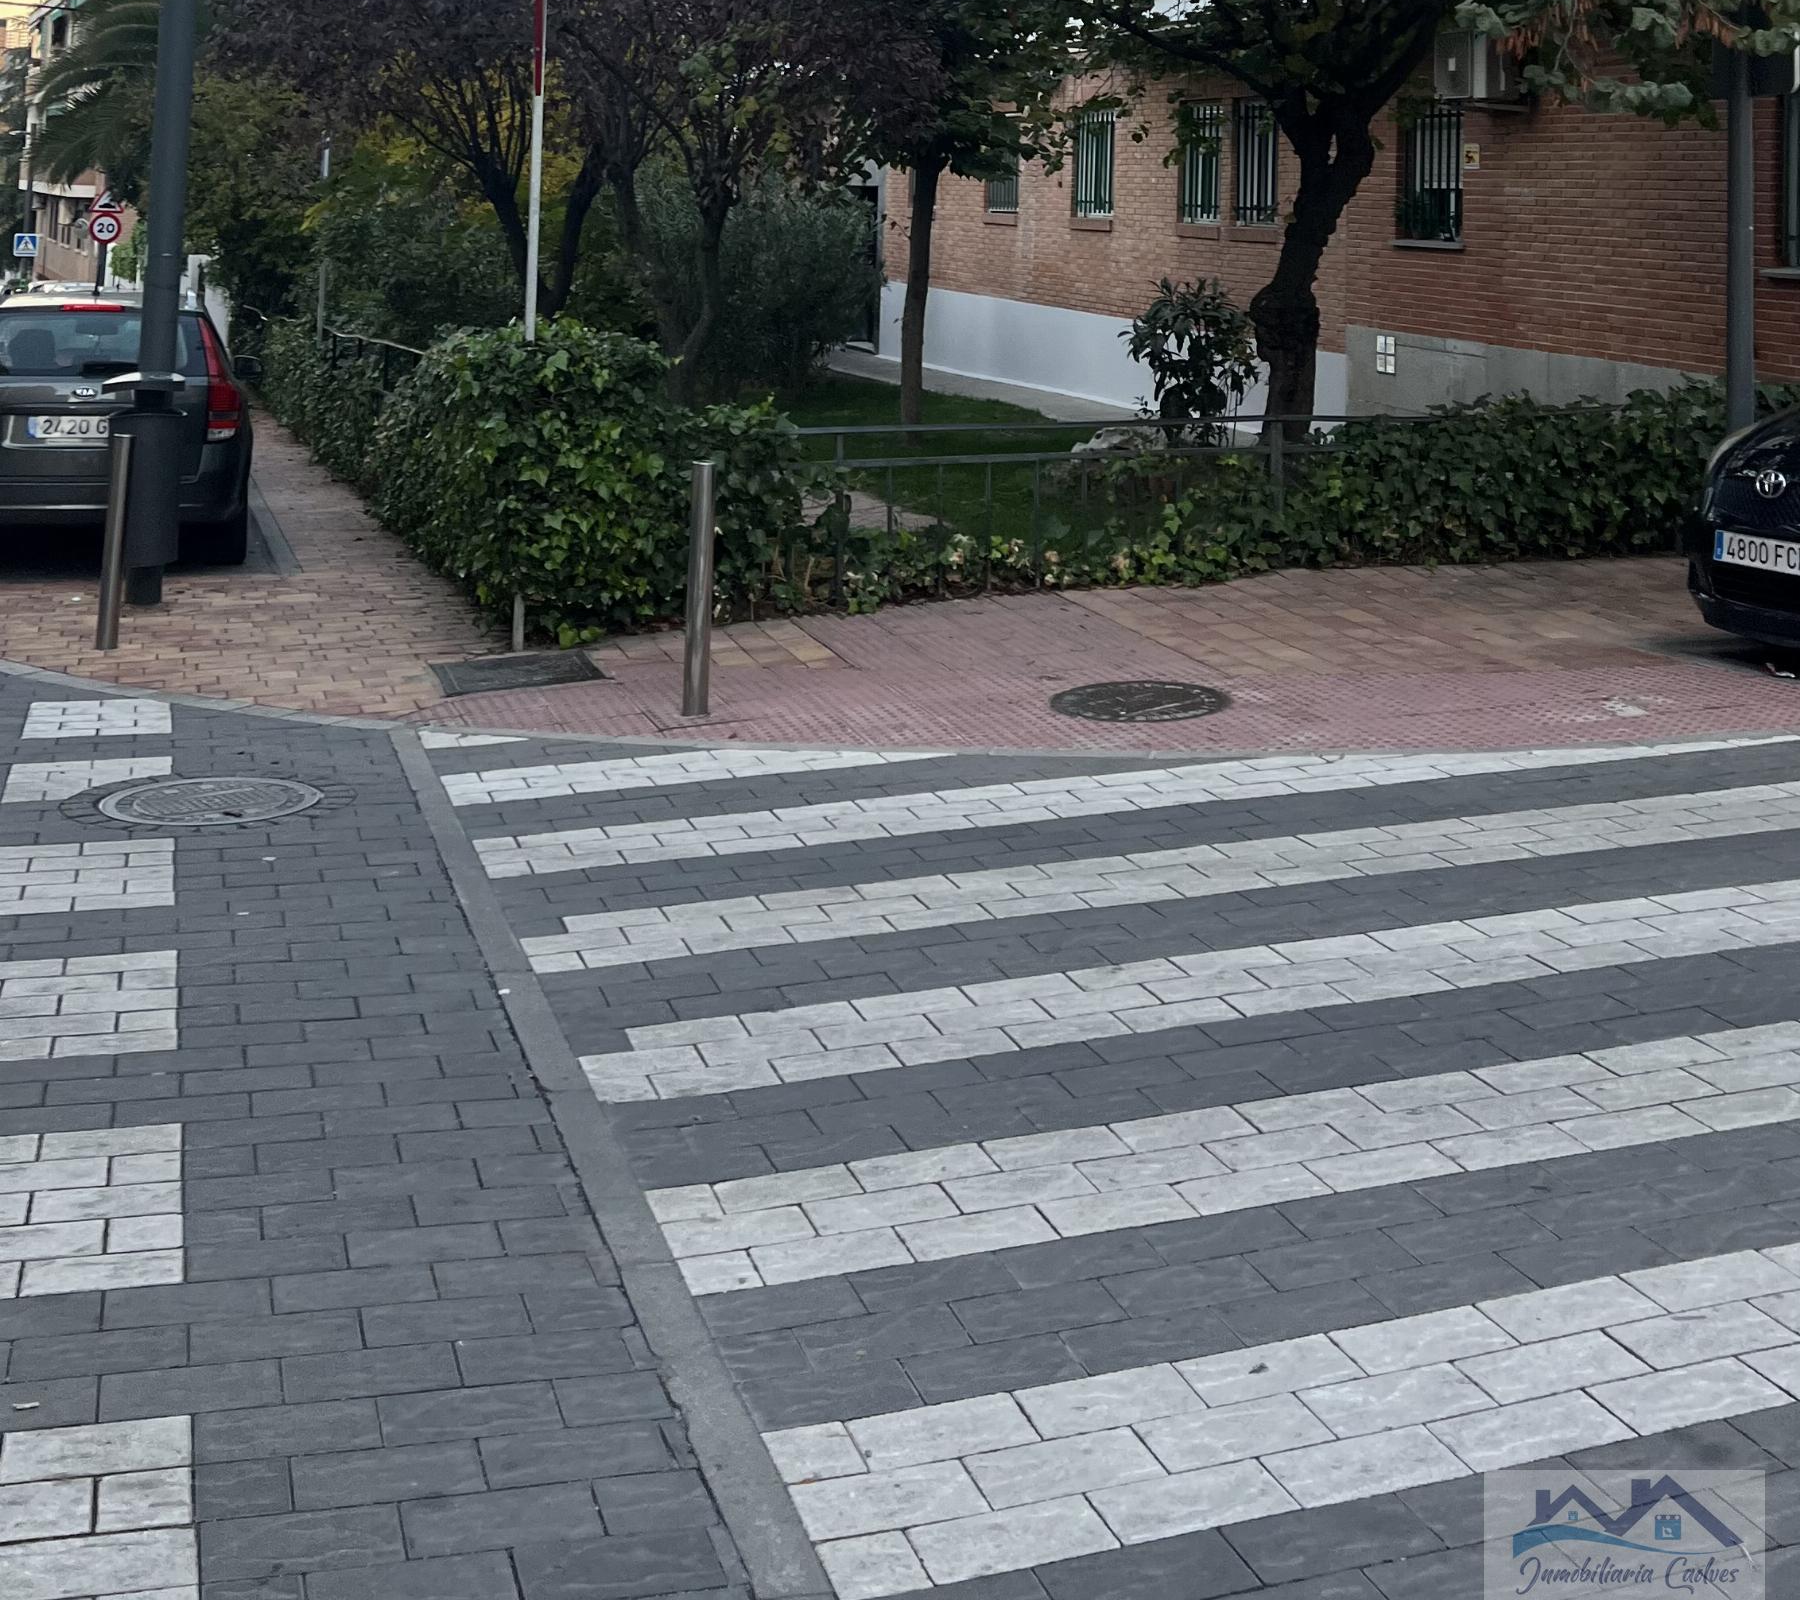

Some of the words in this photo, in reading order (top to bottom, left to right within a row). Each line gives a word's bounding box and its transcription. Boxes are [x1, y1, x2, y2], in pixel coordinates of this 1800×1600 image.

[97, 222, 115, 234] 20
[1726, 536, 1769, 565] 4800
[1774, 543, 1800, 570] FC
